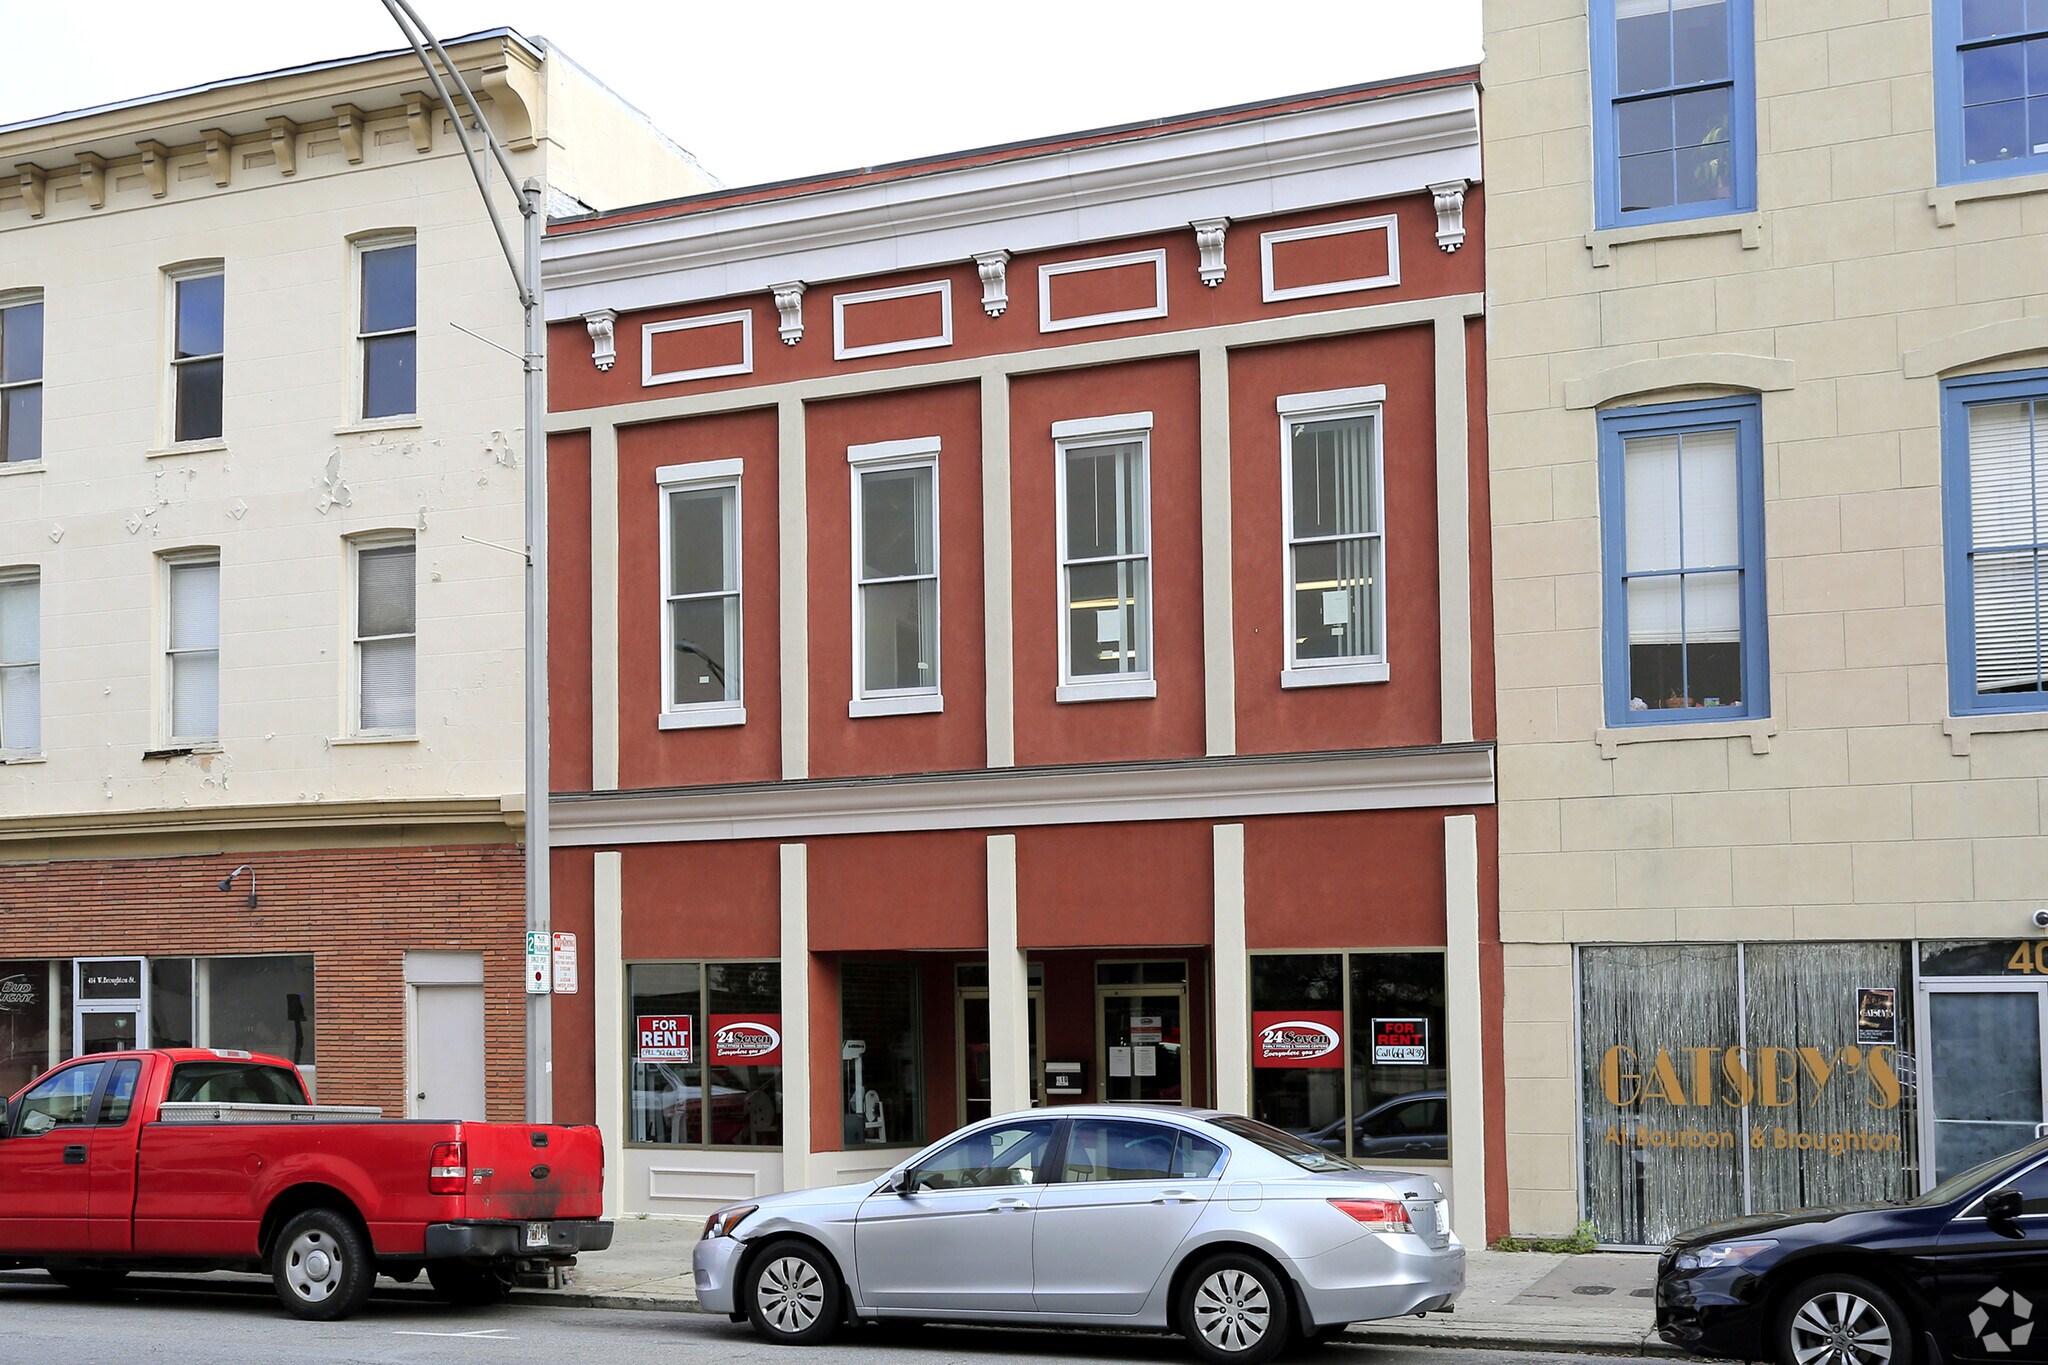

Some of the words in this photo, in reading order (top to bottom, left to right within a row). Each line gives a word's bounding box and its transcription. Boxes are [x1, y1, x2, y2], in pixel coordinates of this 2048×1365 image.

[529, 937, 534, 951] 2
[2, 982, 31, 993] BUD
[0, 993, 34, 1003] IGHT
[652, 1019, 677, 1031] FOR
[1385, 1023, 1415, 1034] FOR
[641, 1031, 689, 1047] RENT
[717, 1031, 734, 1043] 24
[733, 1031, 771, 1044] Seven
[1263, 1030, 1283, 1043] 24
[1282, 1030, 1329, 1044] Seven
[1377, 1034, 1423, 1045] RENT
[1263, 1049, 1299, 1058] Everywhere
[1600, 1045, 1901, 1109] GATSBY'S
[1604, 1125, 1627, 1146] At
[1636, 1125, 1734, 1149] Bourbon
[1750, 1128, 1765, 1149] &
[1773, 1127, 1899, 1156] Broughton
